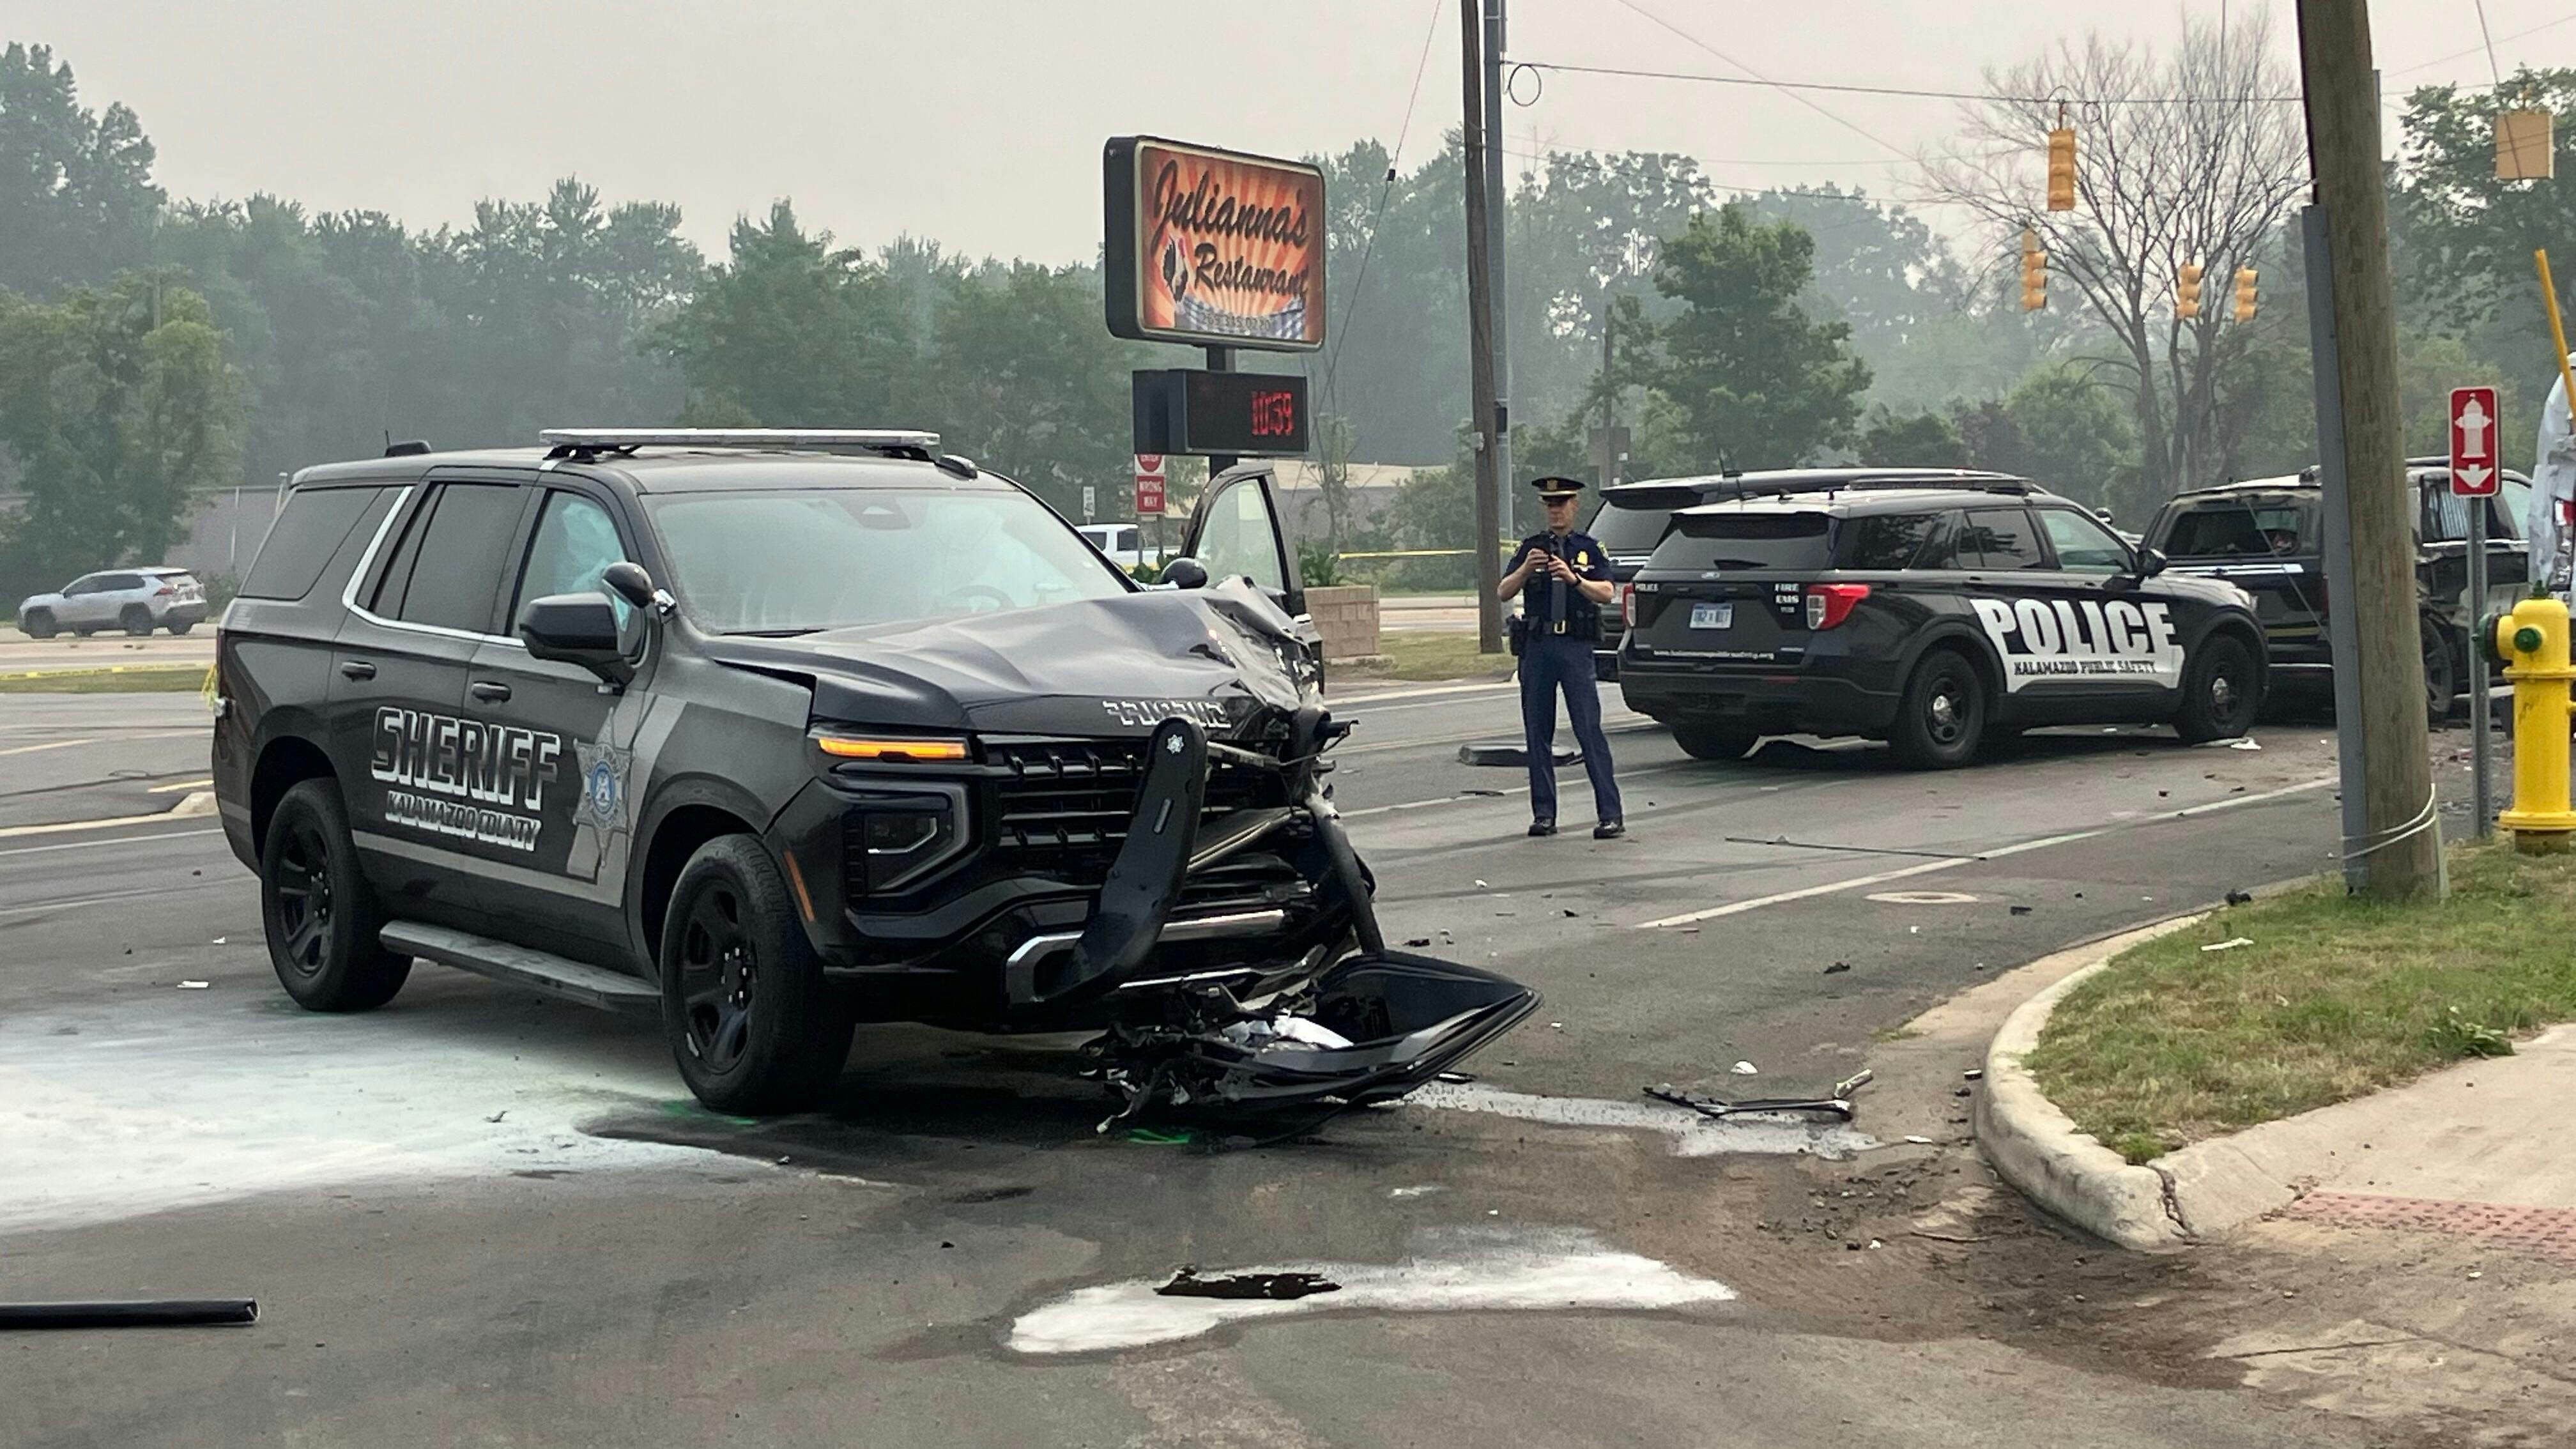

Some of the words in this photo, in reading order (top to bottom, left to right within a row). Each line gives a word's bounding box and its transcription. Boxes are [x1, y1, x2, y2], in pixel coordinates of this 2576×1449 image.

[1152, 159, 1309, 250] Julianna's
[1193, 243, 1309, 299] Restaurant
[1139, 480, 1162, 492] WRONG
[1143, 496, 1158, 507] WAY
[1970, 599, 2181, 655] POLICE
[2014, 660, 2078, 675] KALAMAZOO
[2079, 660, 2117, 675] PUBLIC
[2118, 660, 2158, 675] SAFETY
[371, 706, 562, 811] SHERIFF
[385, 790, 477, 838] KALAMAZOO
[477, 811, 542, 852] COUNTY
